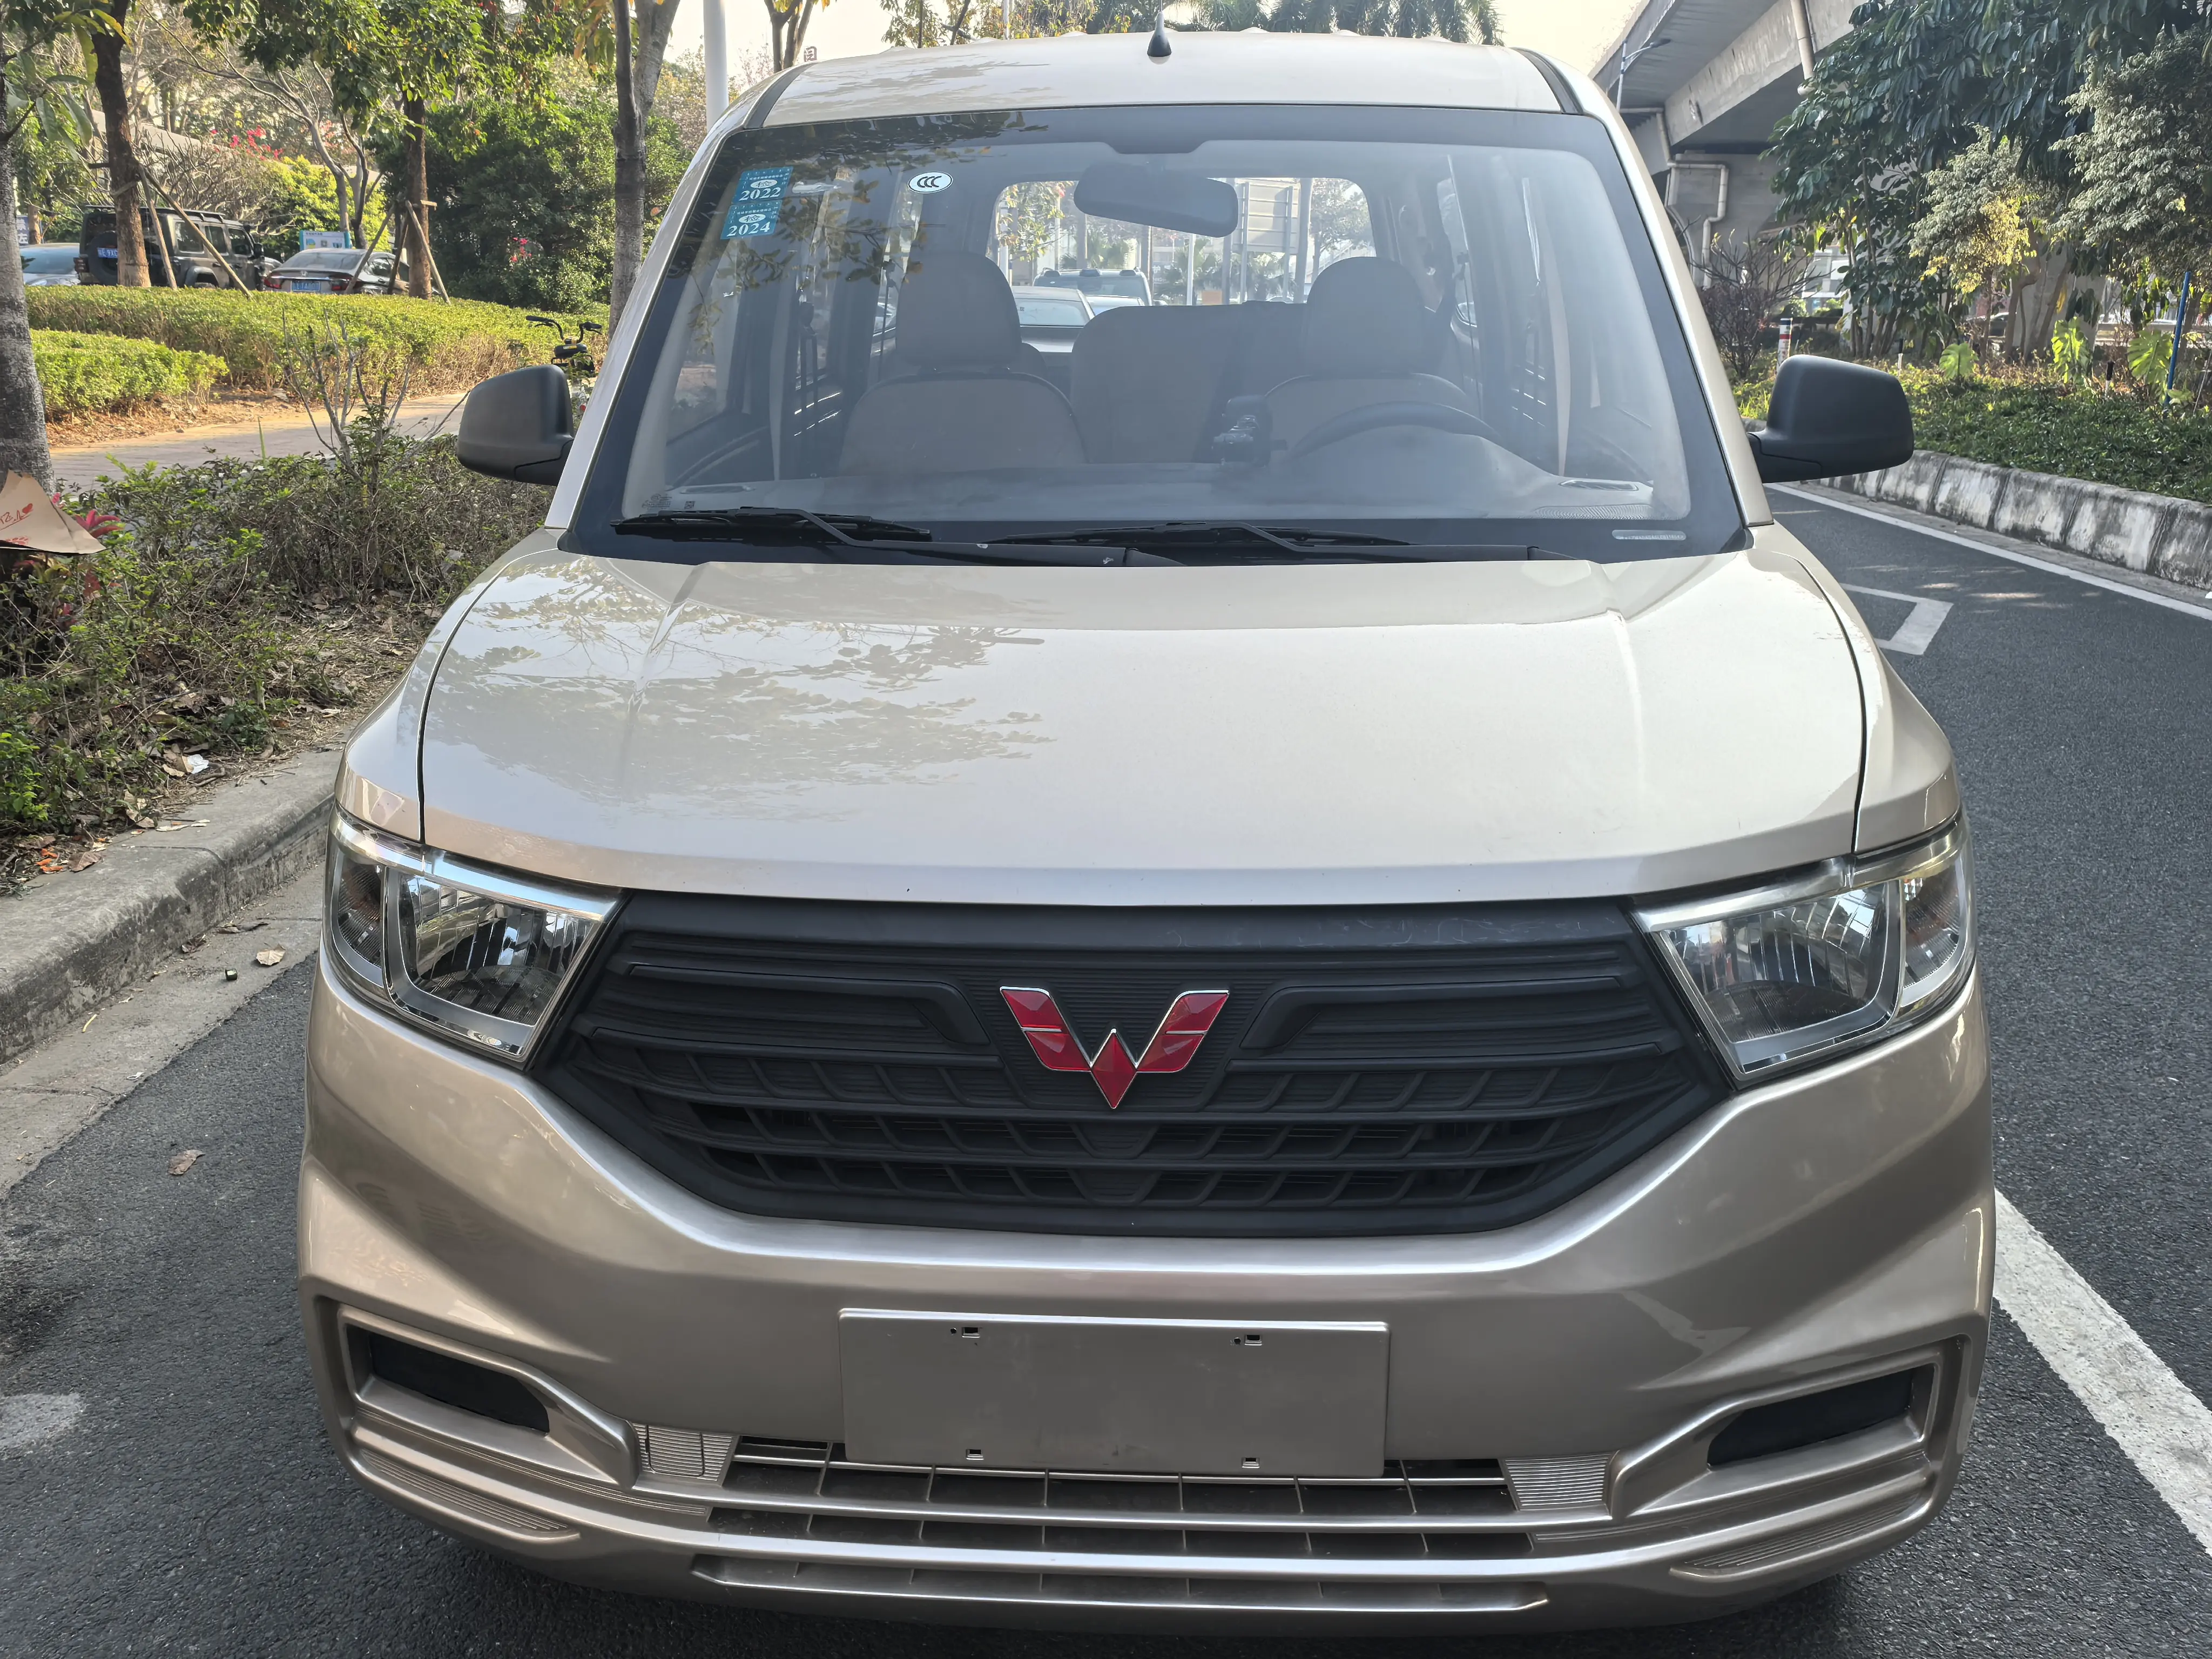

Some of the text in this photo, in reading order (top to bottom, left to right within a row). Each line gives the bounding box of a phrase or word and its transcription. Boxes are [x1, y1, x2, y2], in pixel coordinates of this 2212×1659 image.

[916, 176, 942, 188] CCC
[739, 187, 781, 201] 2022
[726, 221, 770, 237] 2024
